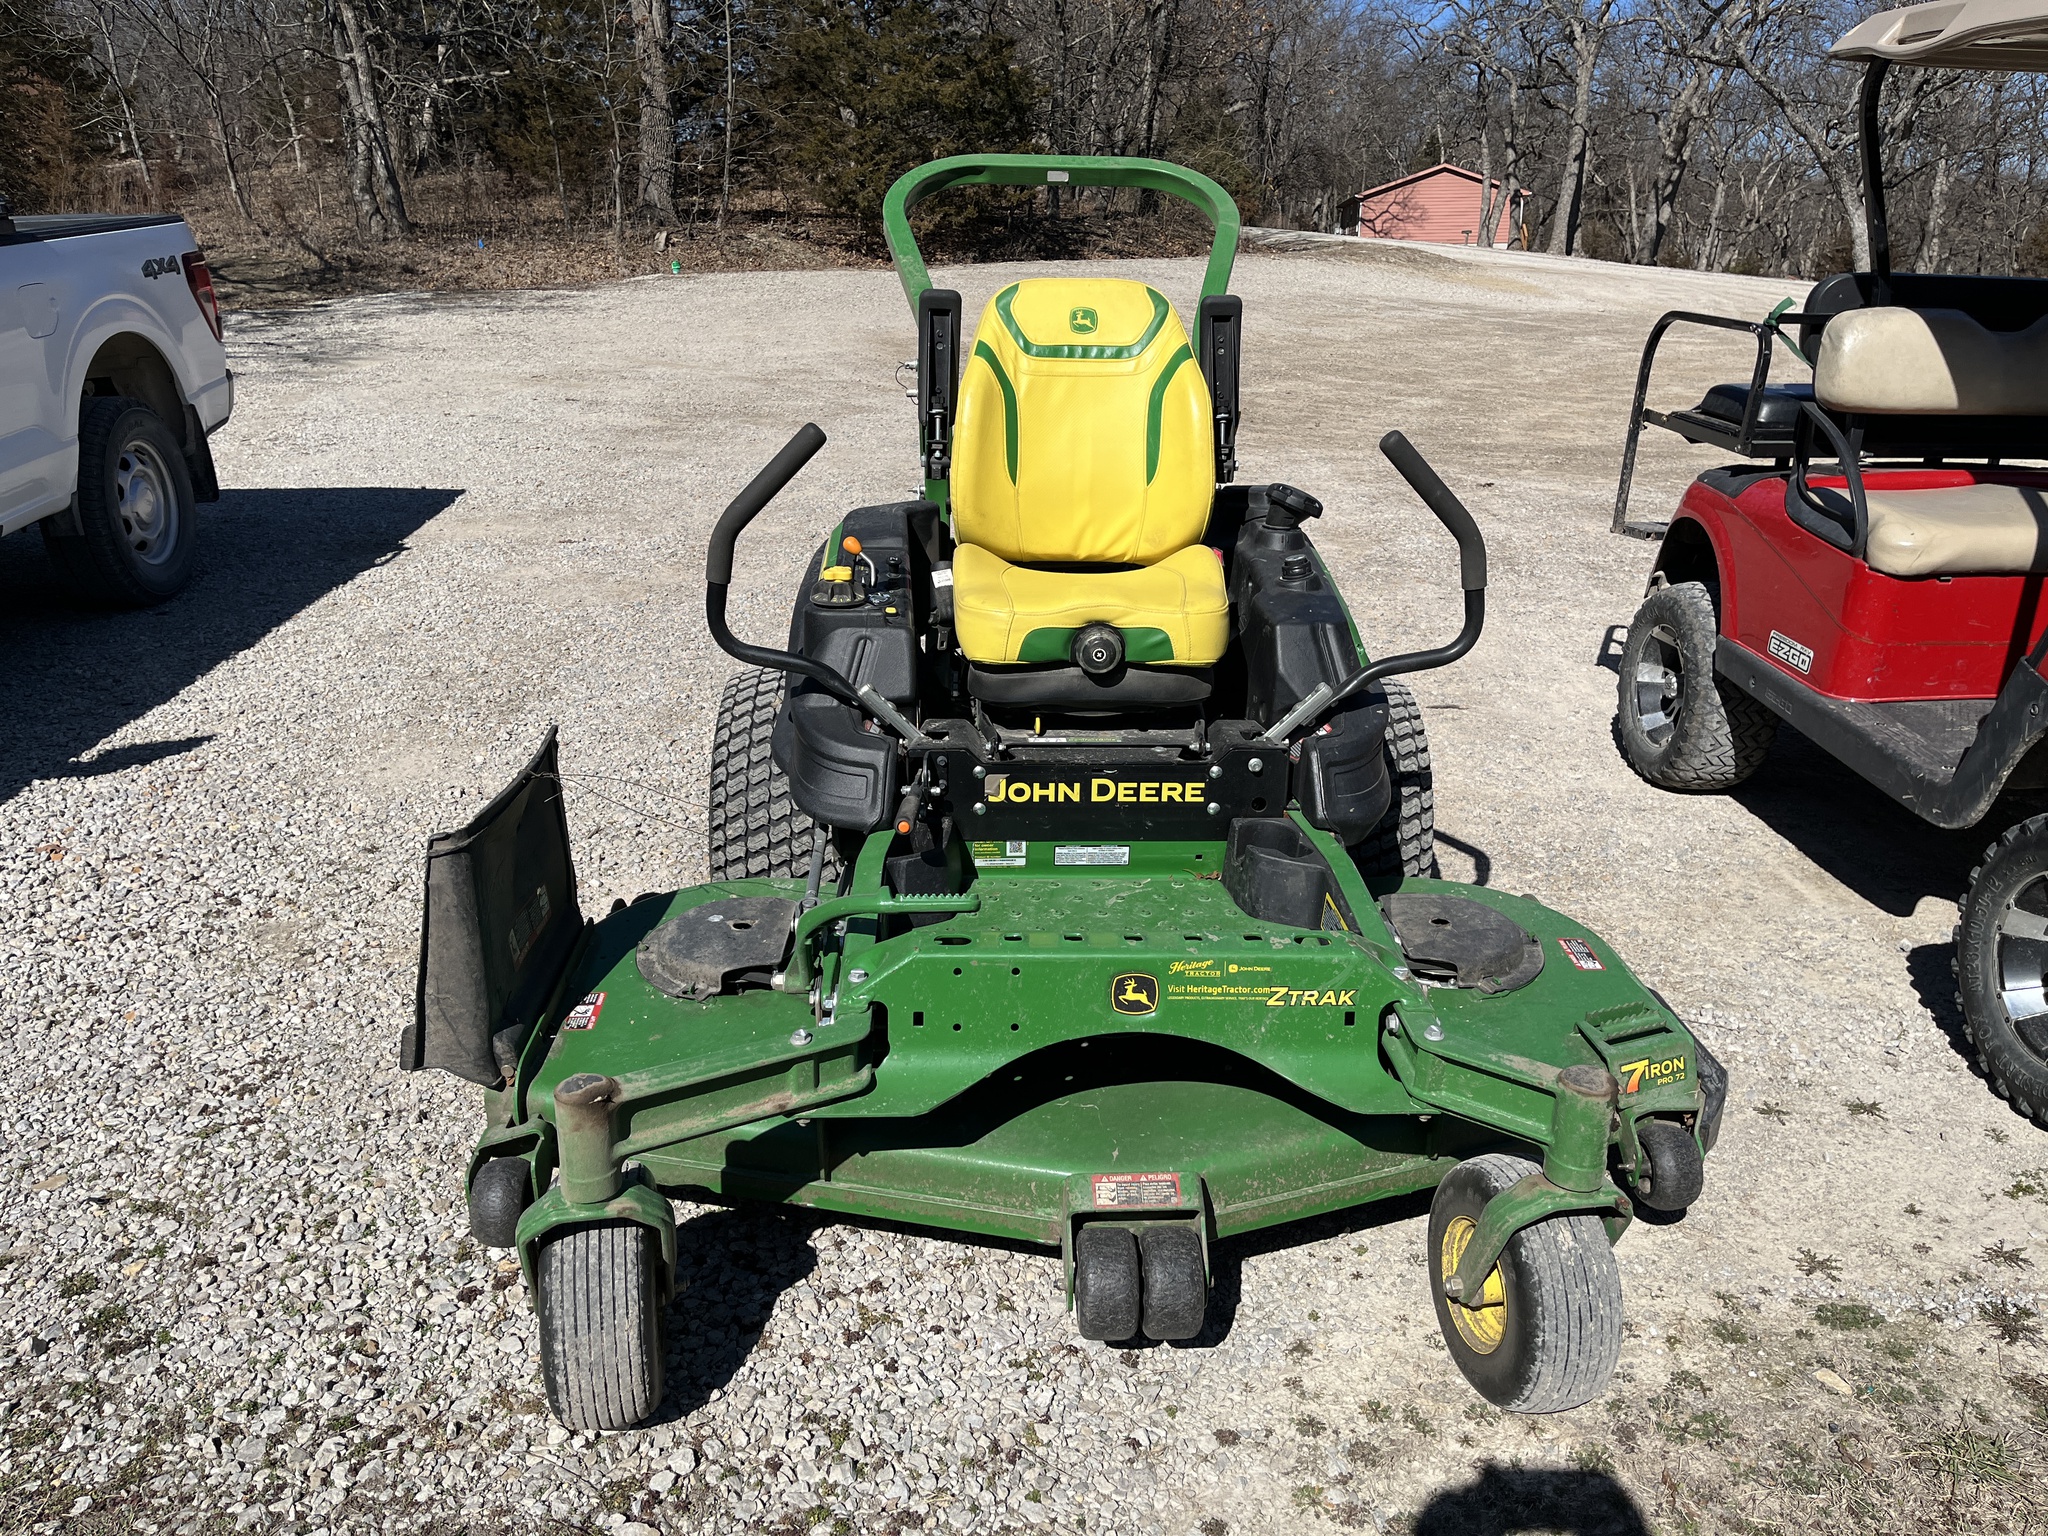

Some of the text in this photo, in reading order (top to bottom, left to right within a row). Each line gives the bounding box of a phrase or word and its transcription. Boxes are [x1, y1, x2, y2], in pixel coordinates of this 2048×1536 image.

[988, 778, 1205, 802] JOHN DEERE
[1168, 959, 1214, 975] Heritage
[1184, 970, 1221, 978] TRACTOR
[1167, 984, 1271, 996] Visit HeritageTractor.com
[1265, 986, 1359, 1006] ZTRAK
[1657, 1072, 1685, 1086] PRO 72
